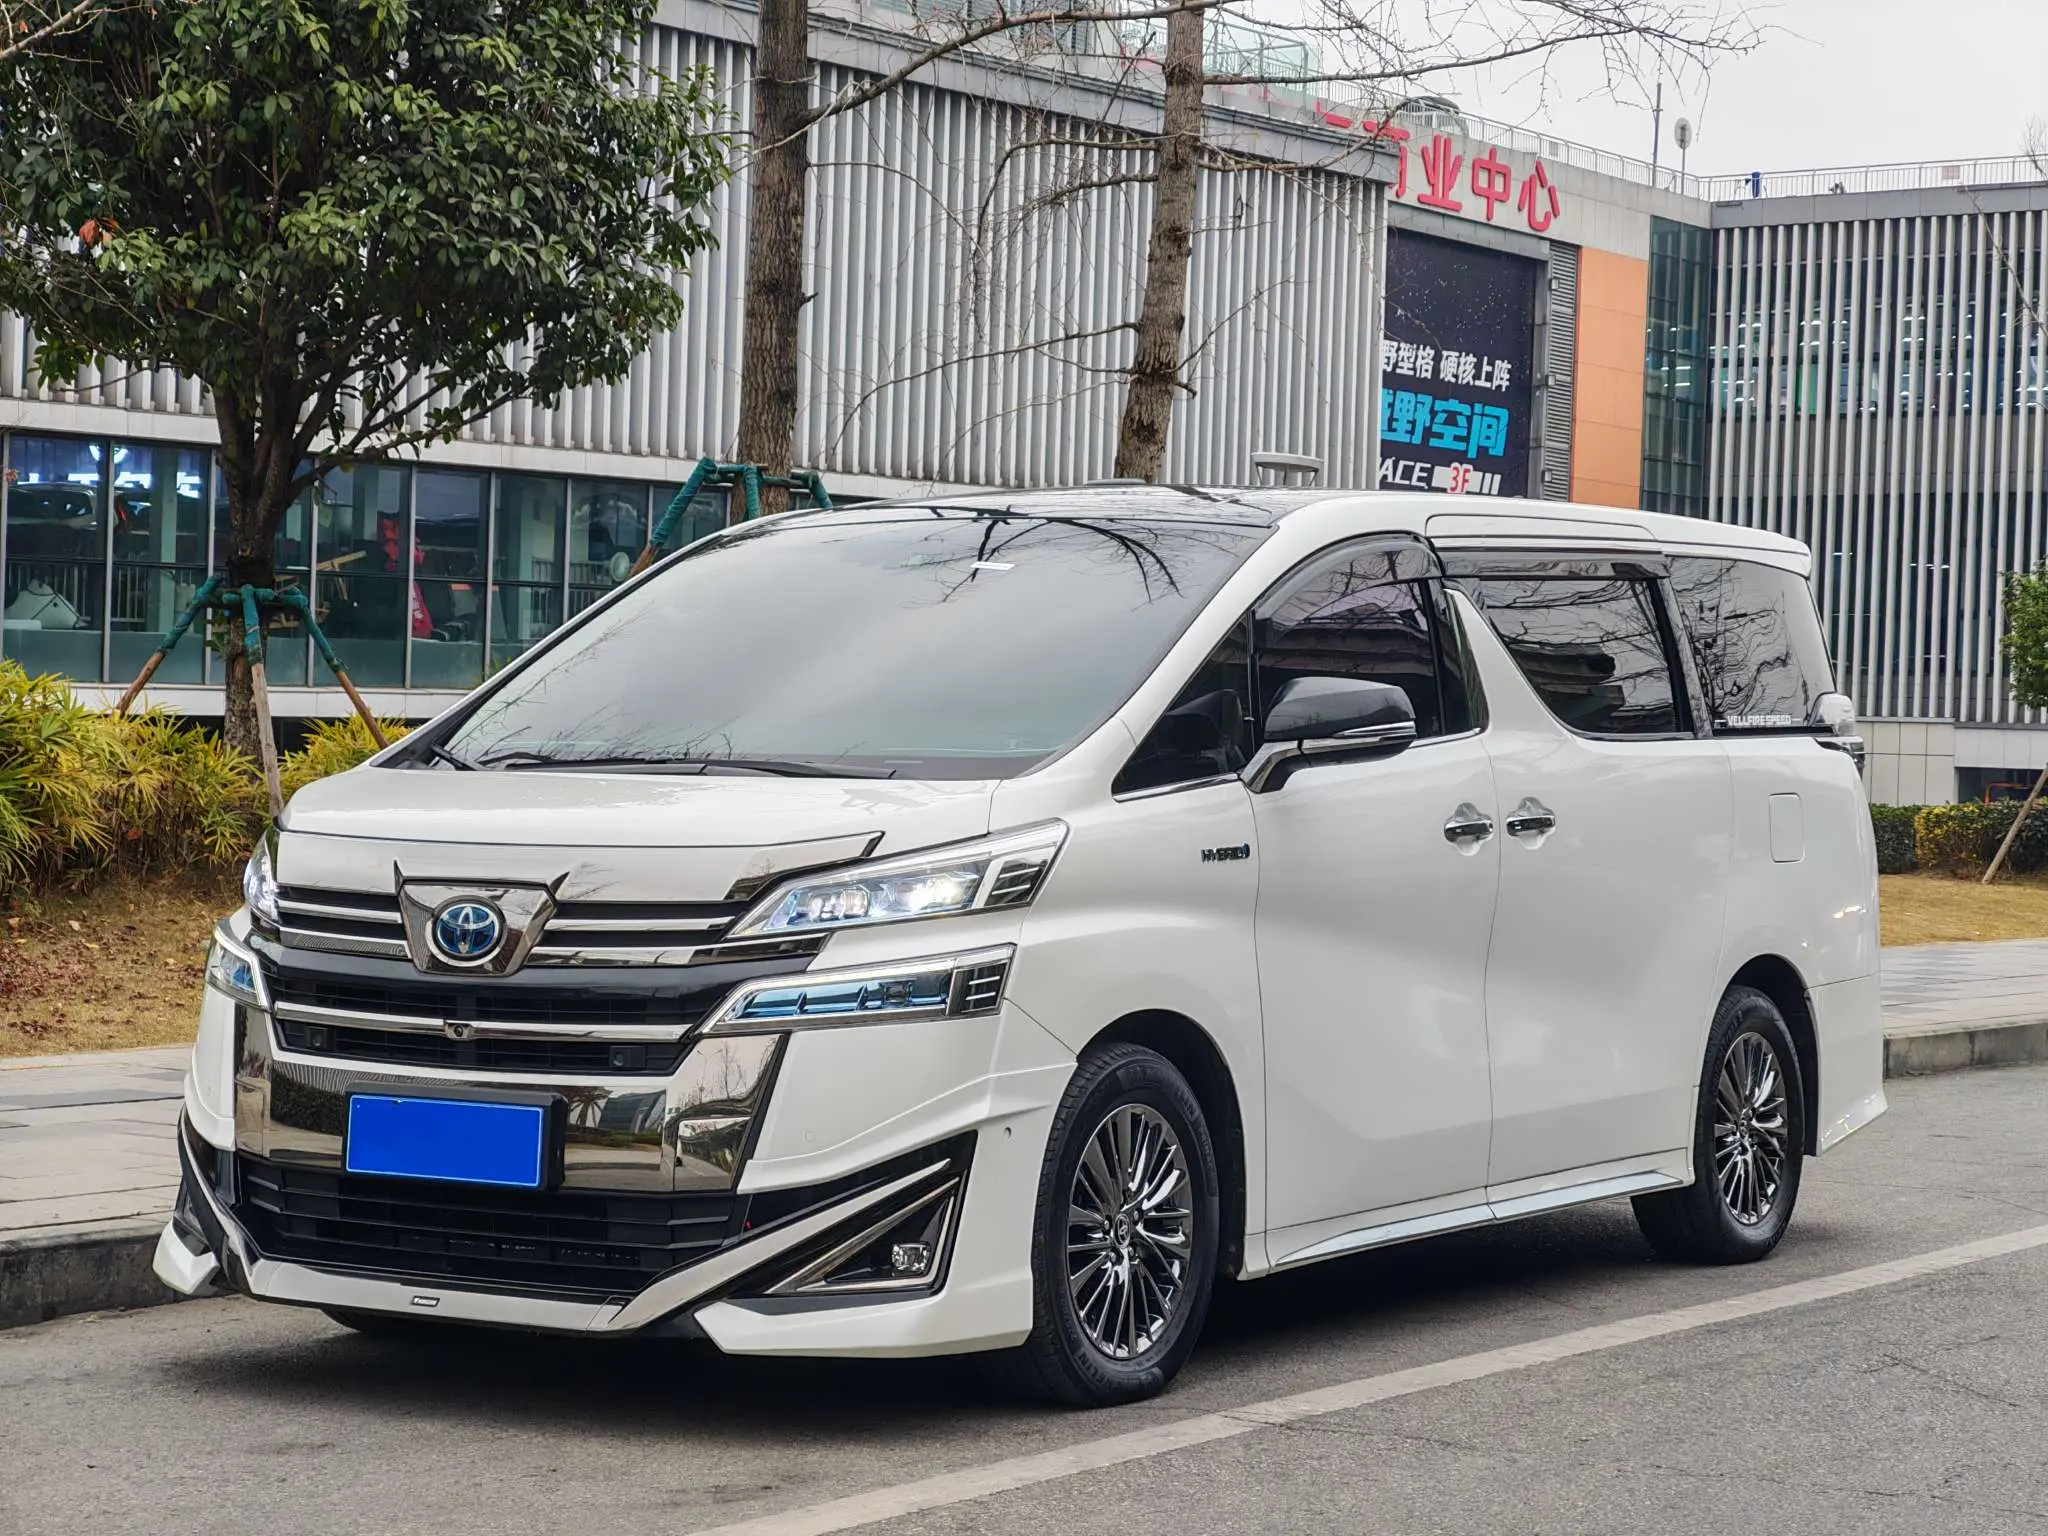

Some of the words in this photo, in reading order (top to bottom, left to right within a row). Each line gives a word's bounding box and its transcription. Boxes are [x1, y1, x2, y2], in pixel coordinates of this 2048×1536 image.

[1440, 350, 1512, 392] 硬核上阵
[1449, 464, 1472, 493] 3F
